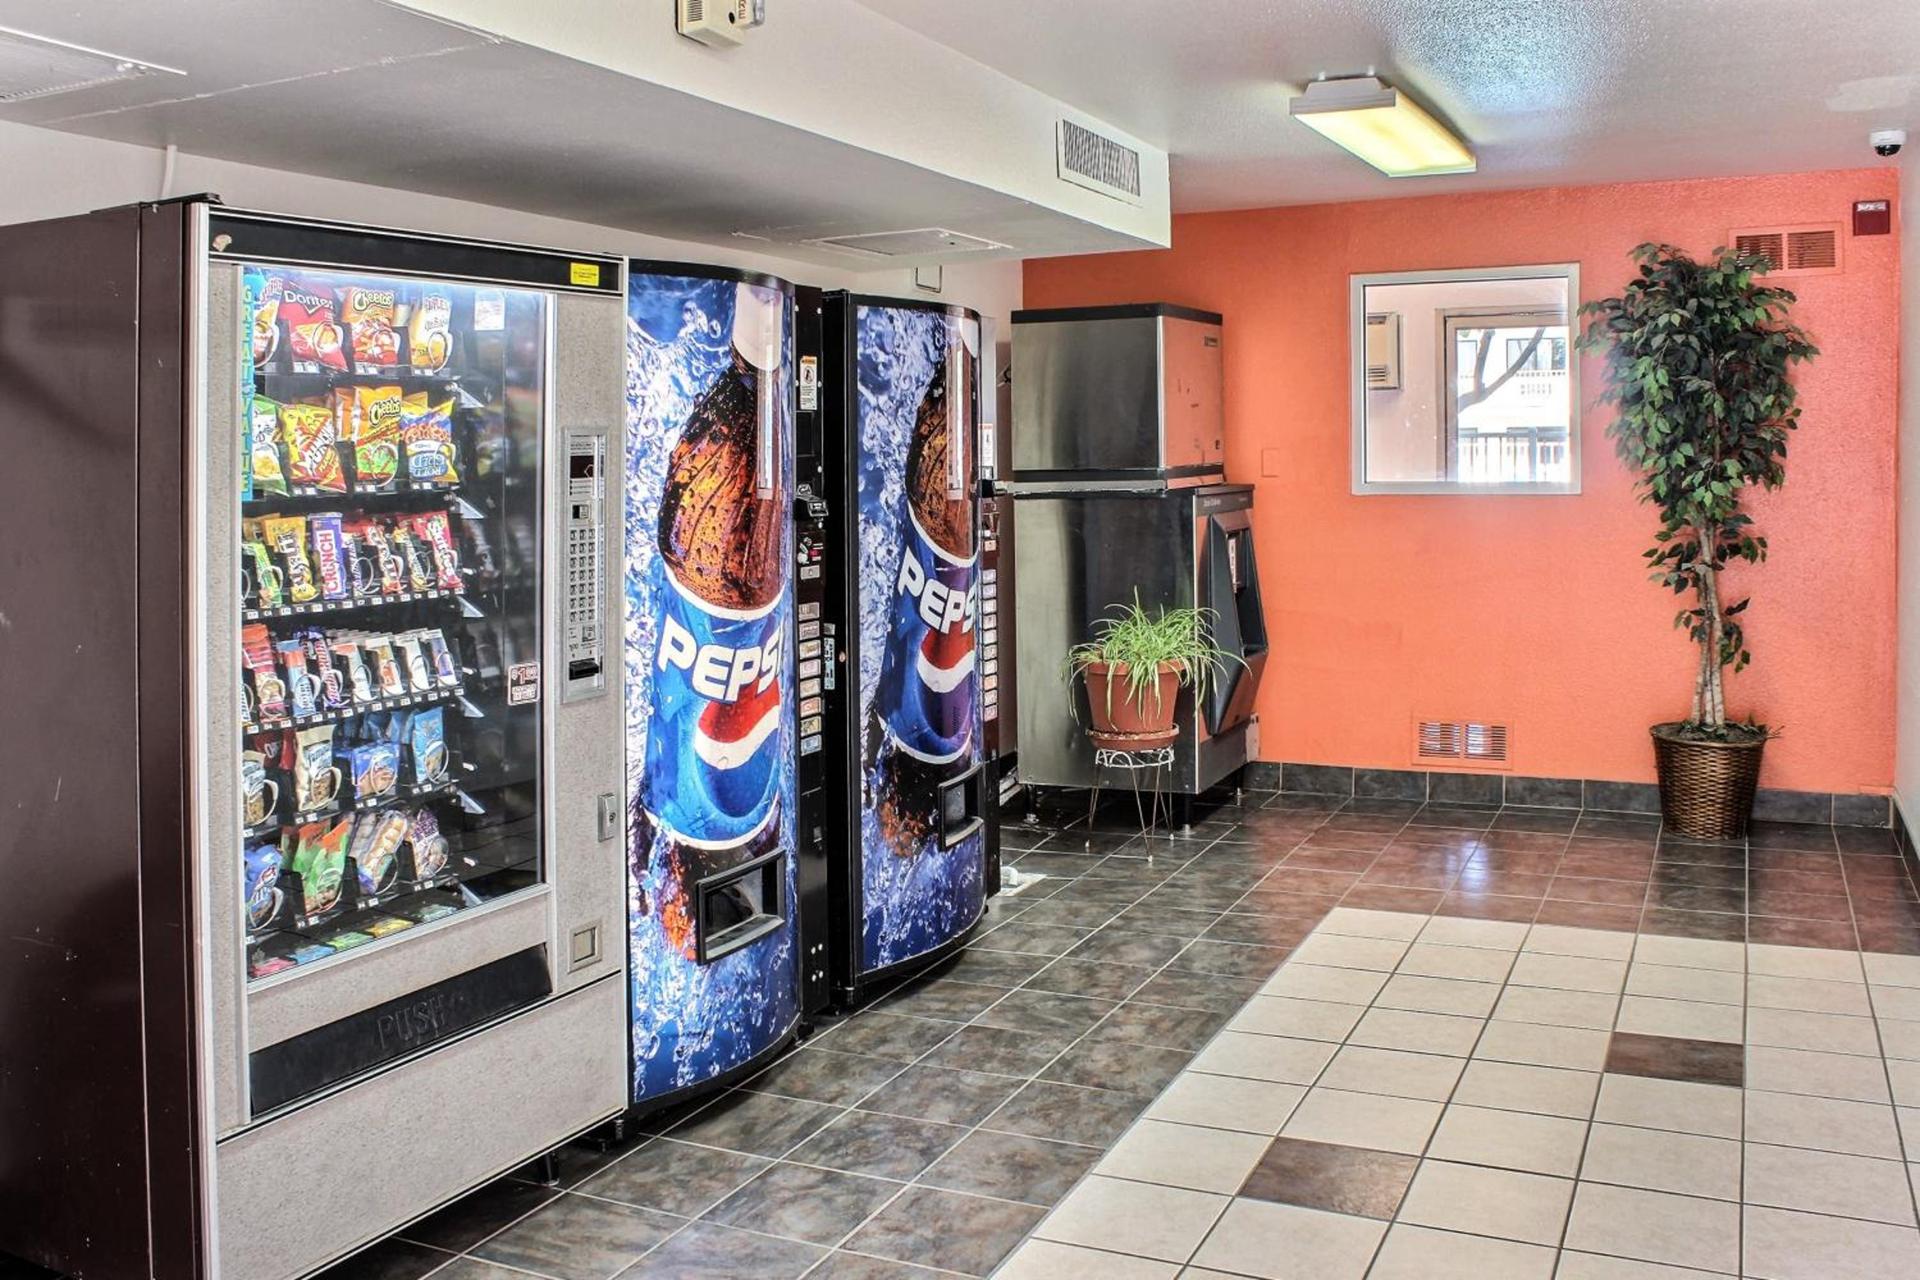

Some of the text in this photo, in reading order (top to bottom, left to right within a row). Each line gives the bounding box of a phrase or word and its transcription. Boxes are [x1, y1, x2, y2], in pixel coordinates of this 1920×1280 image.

[353, 290, 393, 311] Cheetos
[318, 531, 339, 593] CRUNCH
[376, 992, 446, 1050] PUSH
